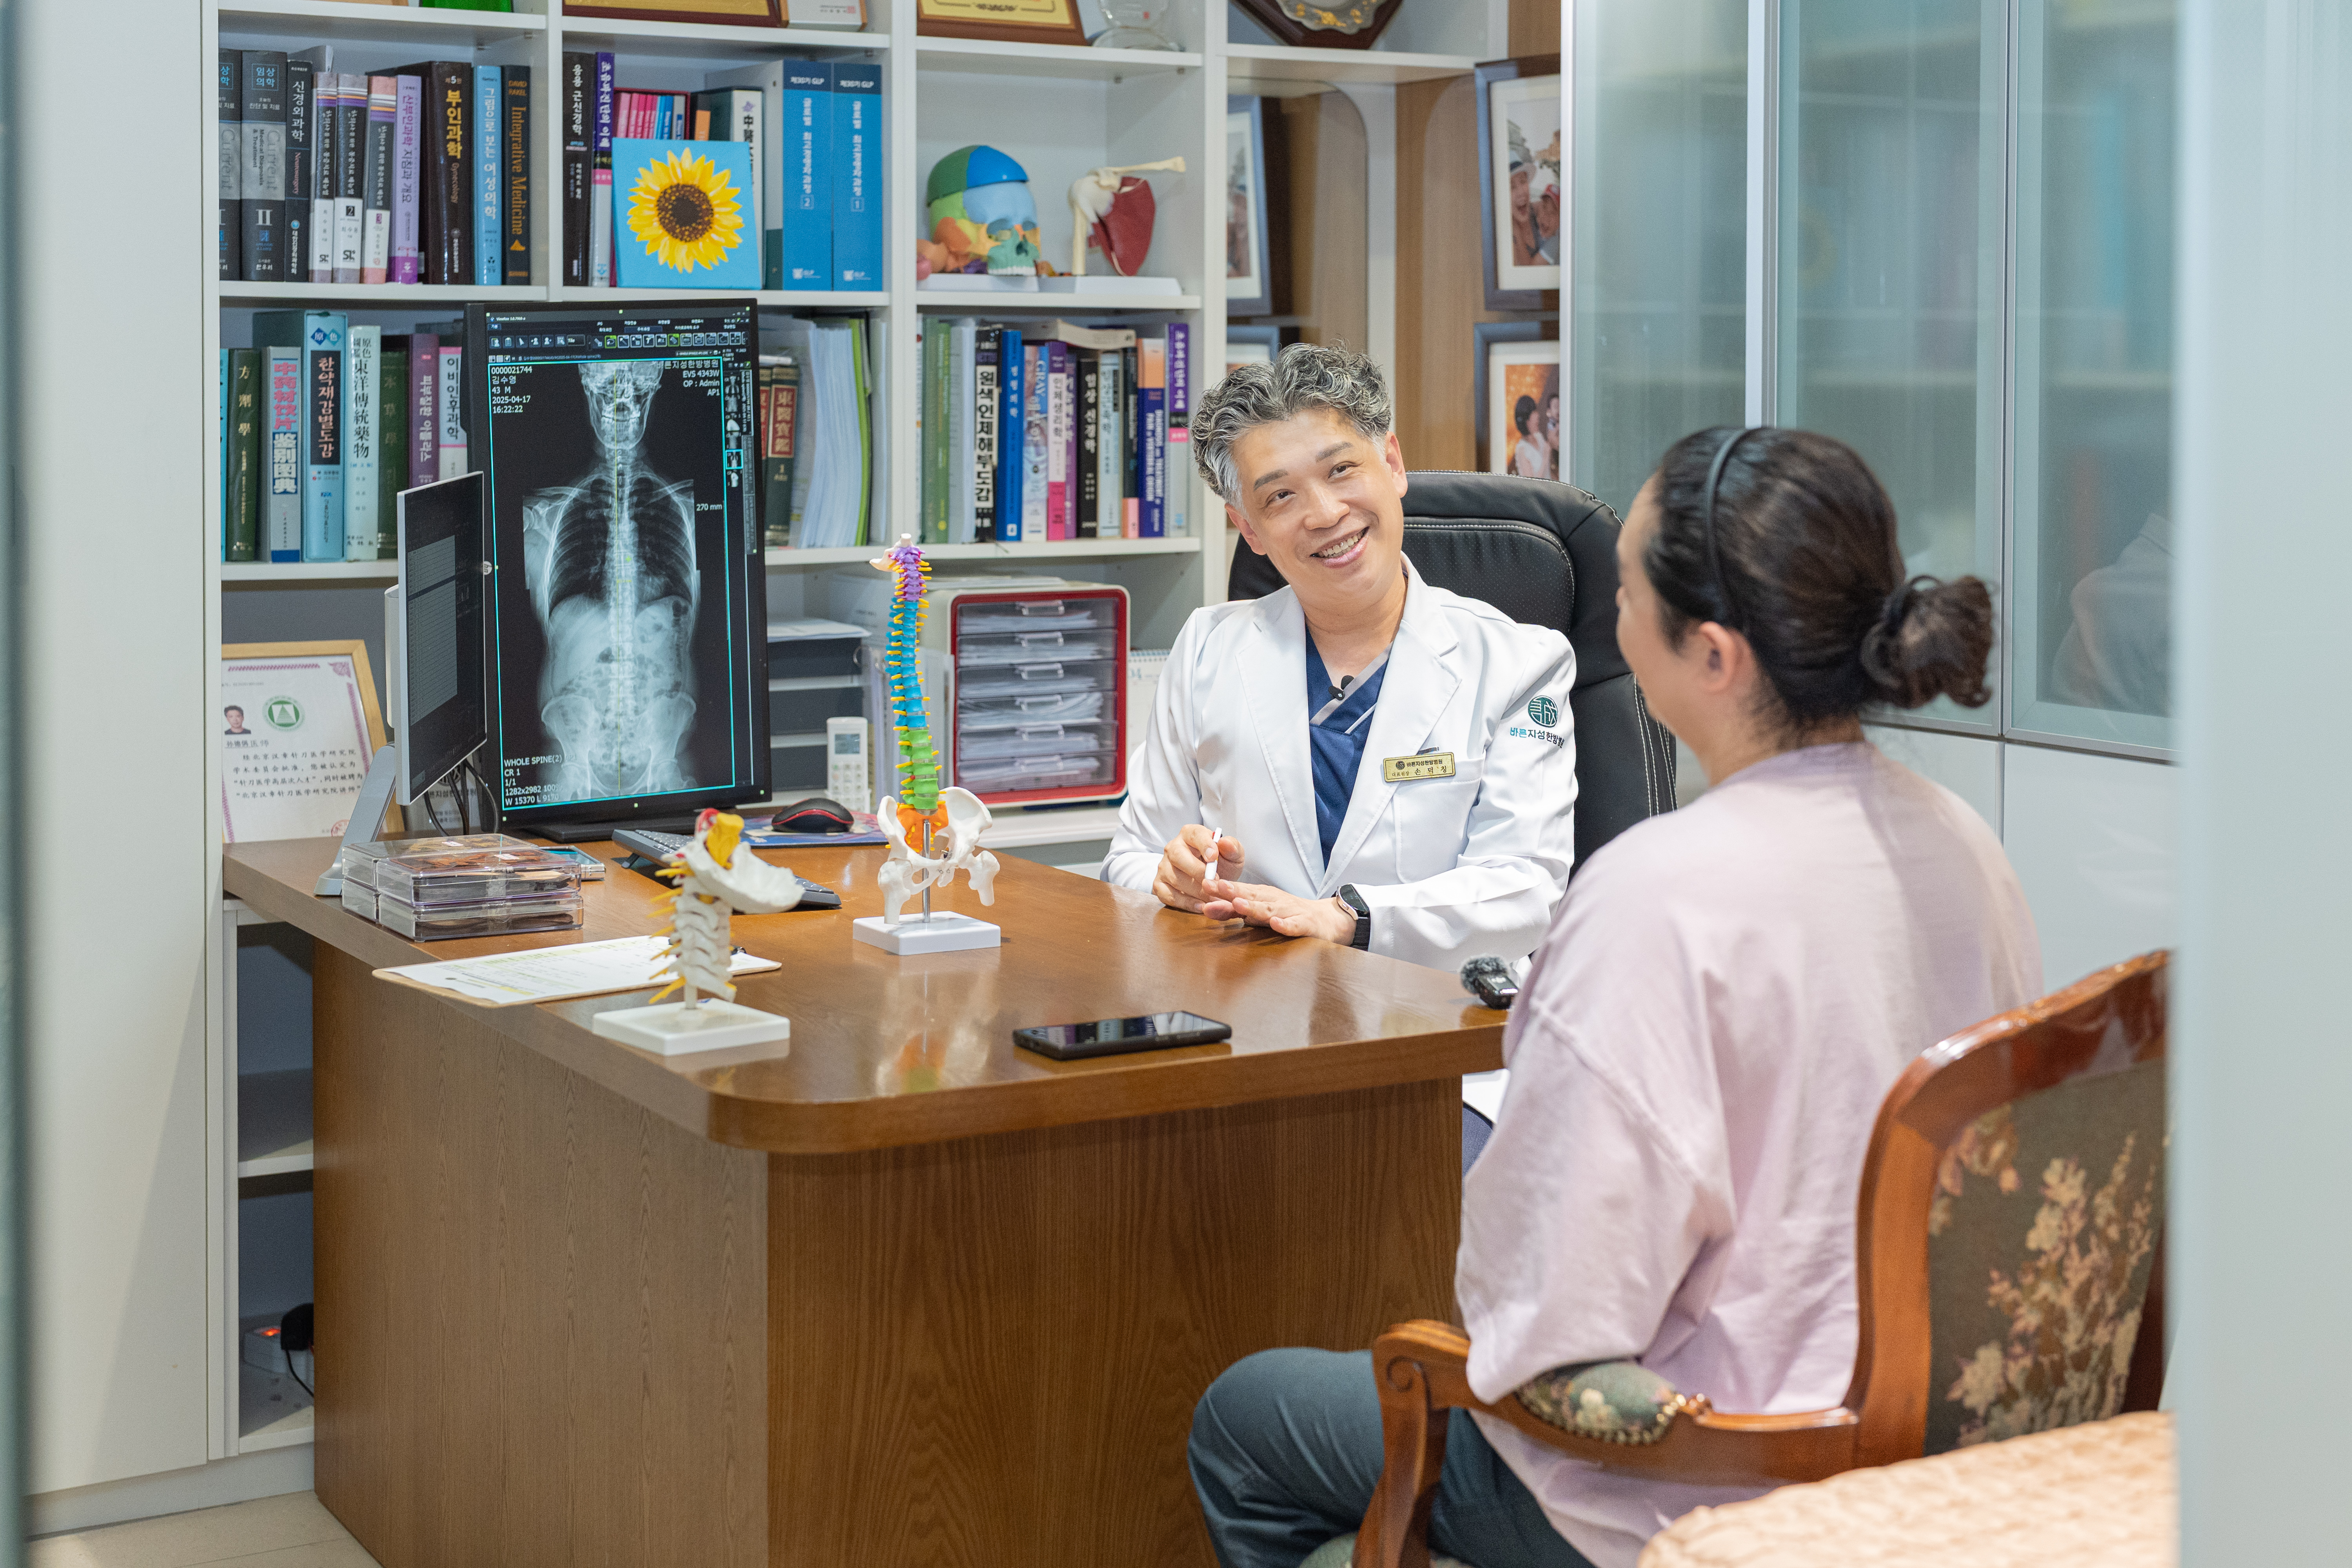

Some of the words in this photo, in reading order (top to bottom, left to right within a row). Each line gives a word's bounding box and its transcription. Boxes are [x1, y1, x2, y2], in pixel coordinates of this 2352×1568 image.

[256, 67, 275, 77] 임상
[256, 78, 275, 87] 의학
[572, 64, 583, 87] 응용
[292, 80, 305, 142] 신경외과학
[402, 94, 413, 146] 산부인과학
[484, 88, 496, 132] 그림으로
[572, 91, 583, 136] 근신경학
[446, 90, 463, 159] 부인과학
[484, 135, 496, 158] 보는
[509, 107, 526, 172] Integrative
[401, 149, 413, 179] 지침과
[401, 182, 412, 203] 개요
[484, 162, 497, 220] 여성의학
[512, 176, 527, 235] Medicine
[256, 209, 273, 226] II
[314, 332, 338, 341] 原色
[491, 366, 532, 374] 0000021744
[492, 375, 516, 385] 김수영
[274, 362, 297, 430] 中药材饮片
[318, 356, 335, 458] 한약재감별도감
[419, 375, 432, 416] 피부질환
[447, 357, 460, 440] 이비인후과학
[492, 395, 531, 404] 2025-04-17
[492, 405, 523, 414] 16:22:22
[419, 419, 432, 463] 아틀라스
[976, 371, 994, 501] 원색인체해부도감
[504, 758, 530, 767] WHOLE
[531, 755, 563, 764] SPINE(2)
[1406, 759, 1443, 767] 바른지성한방병원
[505, 778, 516, 787] 1/1
[505, 785, 542, 796] 1282x2982
[544, 784, 563, 793] 100%
[505, 798, 513, 806] W
[515, 795, 535, 805] 15370
[543, 793, 559, 802] 9170
